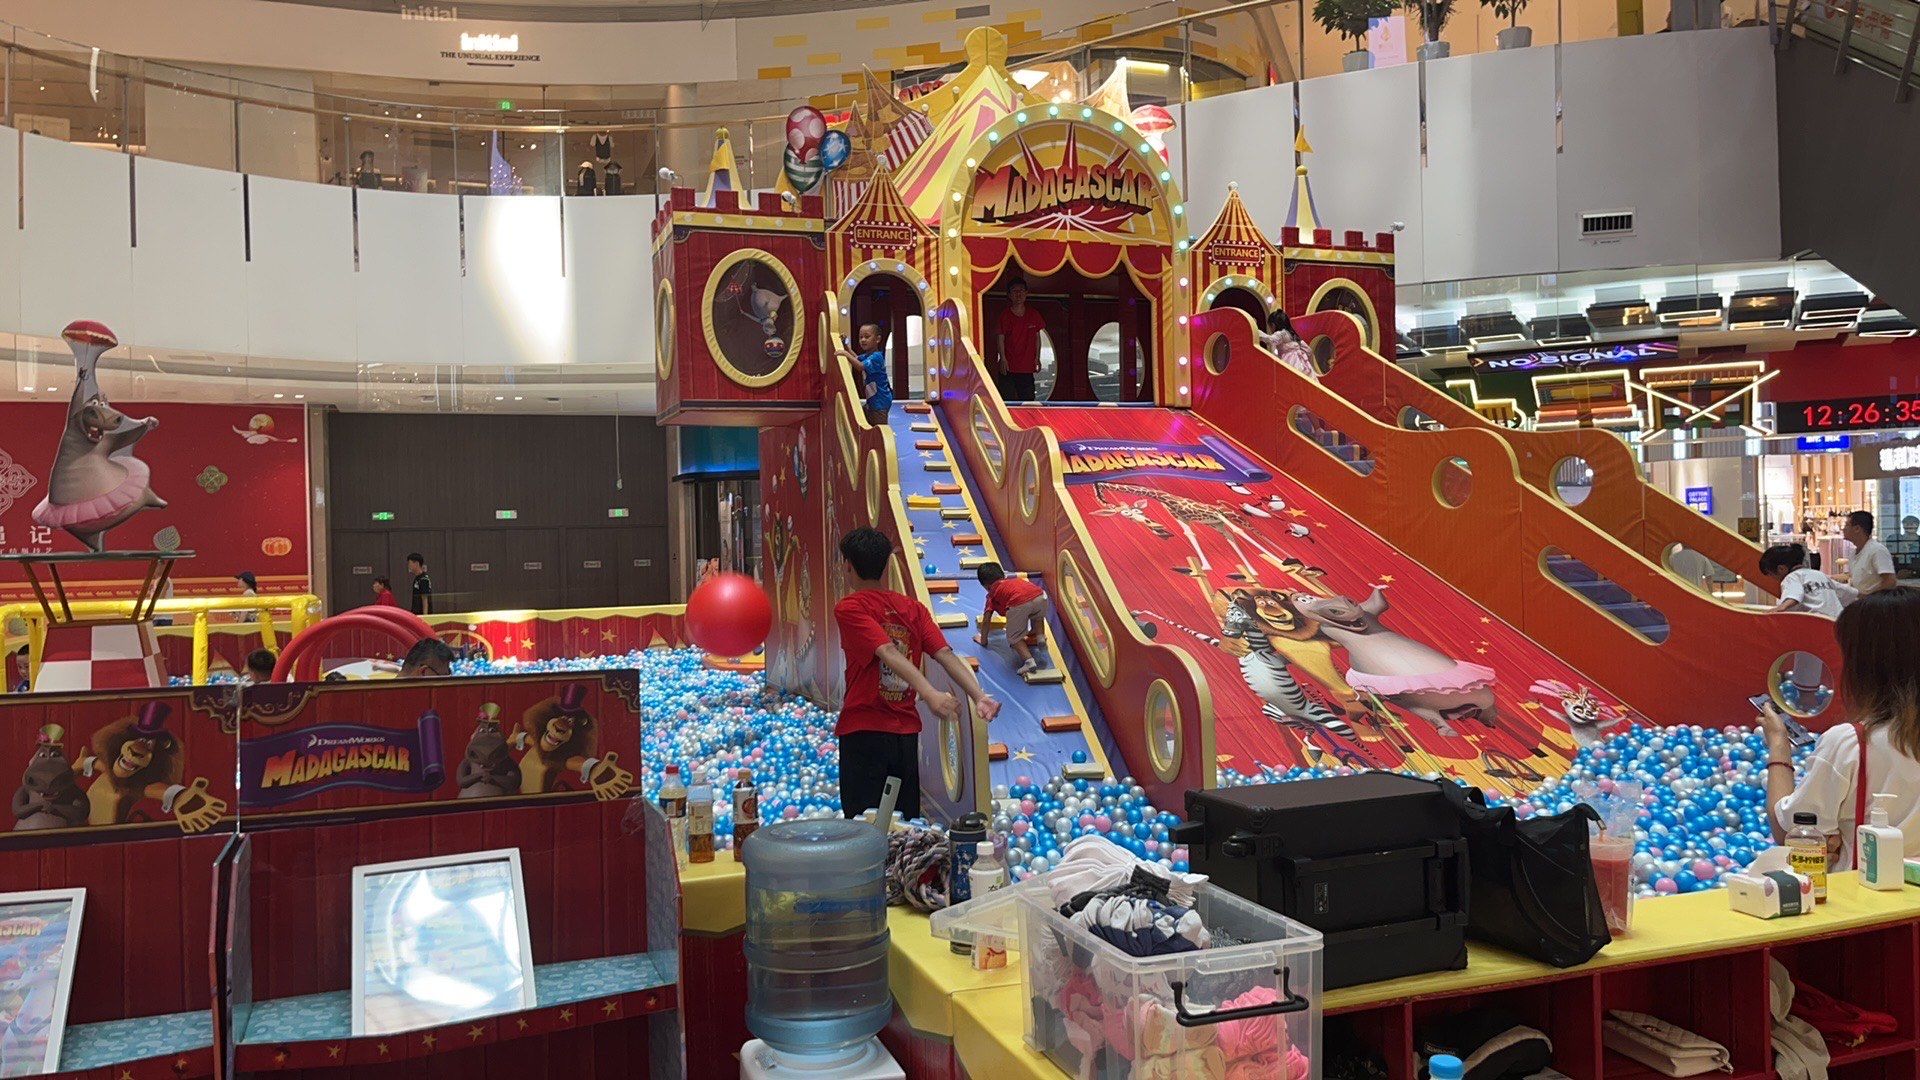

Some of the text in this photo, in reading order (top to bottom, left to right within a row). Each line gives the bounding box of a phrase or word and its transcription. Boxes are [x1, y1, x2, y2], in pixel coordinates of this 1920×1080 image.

[461, 33, 519, 52] initial
[440, 51, 457, 59] THE
[495, 54, 541, 62] EXPERIENCE
[971, 164, 1154, 223] MADAGASCAR
[856, 229, 910, 241] ENTRANCE
[1214, 247, 1259, 258] ENTRANCE
[1488, 347, 1658, 369] NO SIGNAL
[1803, 400, 1920, 426] 12:26:35
[261, 745, 411, 788] MADAGASCAR
